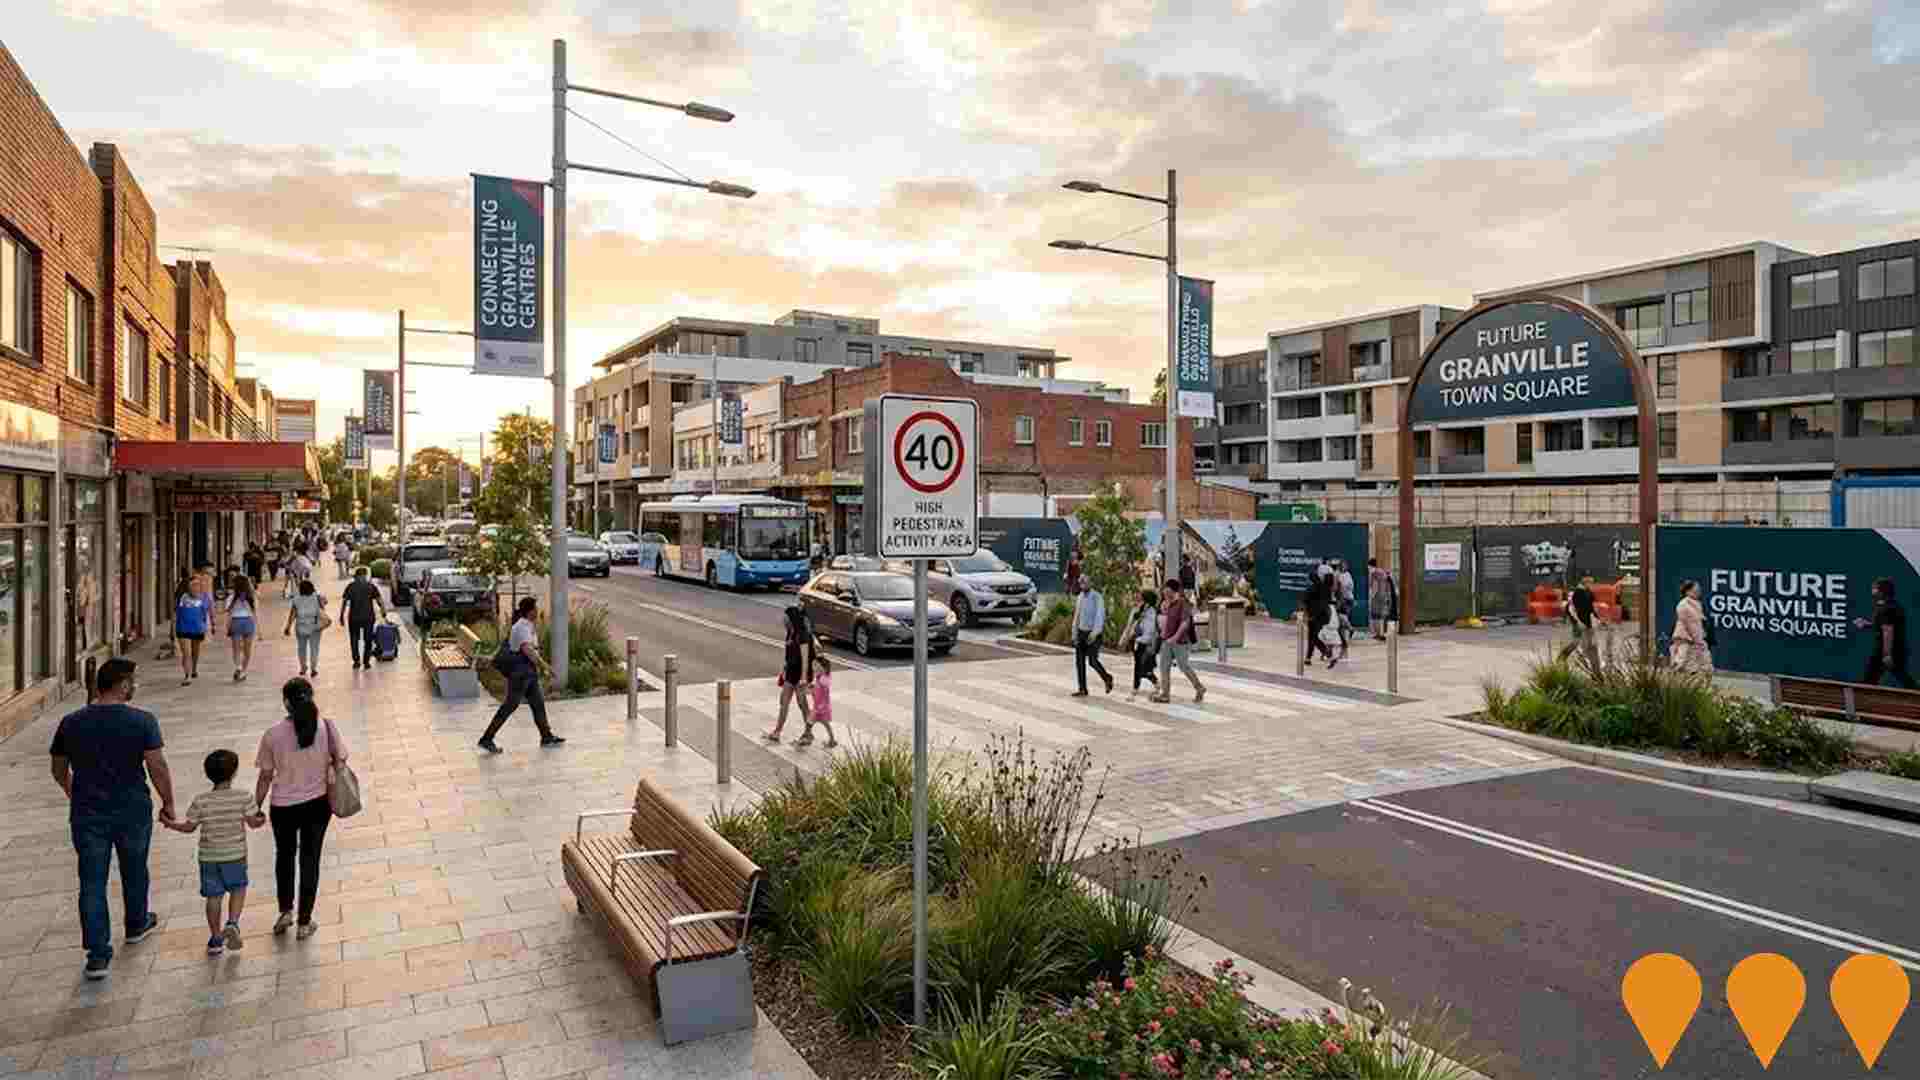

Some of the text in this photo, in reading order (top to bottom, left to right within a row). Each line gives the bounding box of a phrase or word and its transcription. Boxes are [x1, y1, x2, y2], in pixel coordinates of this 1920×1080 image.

[481, 199, 498, 326] CONNECTING
[501, 219, 517, 328] GRANVILLE
[519, 243, 536, 329] CENTRES
[1477, 321, 1548, 348] FUTURE
[1439, 341, 1589, 383] GRANVILLE
[1439, 375, 1590, 407] TOWN SQUARE
[904, 433, 954, 471] 40
[914, 501, 943, 513] HIGH
[893, 517, 964, 531] PEDESTRIAN
[885, 534, 937, 548] ACTIVITY
[941, 535, 972, 549] AREA
[1711, 569, 1847, 599] FUTURE
[1710, 595, 1847, 620] GRANVILLE
[1710, 613, 1847, 639] TOWN SQUARE
